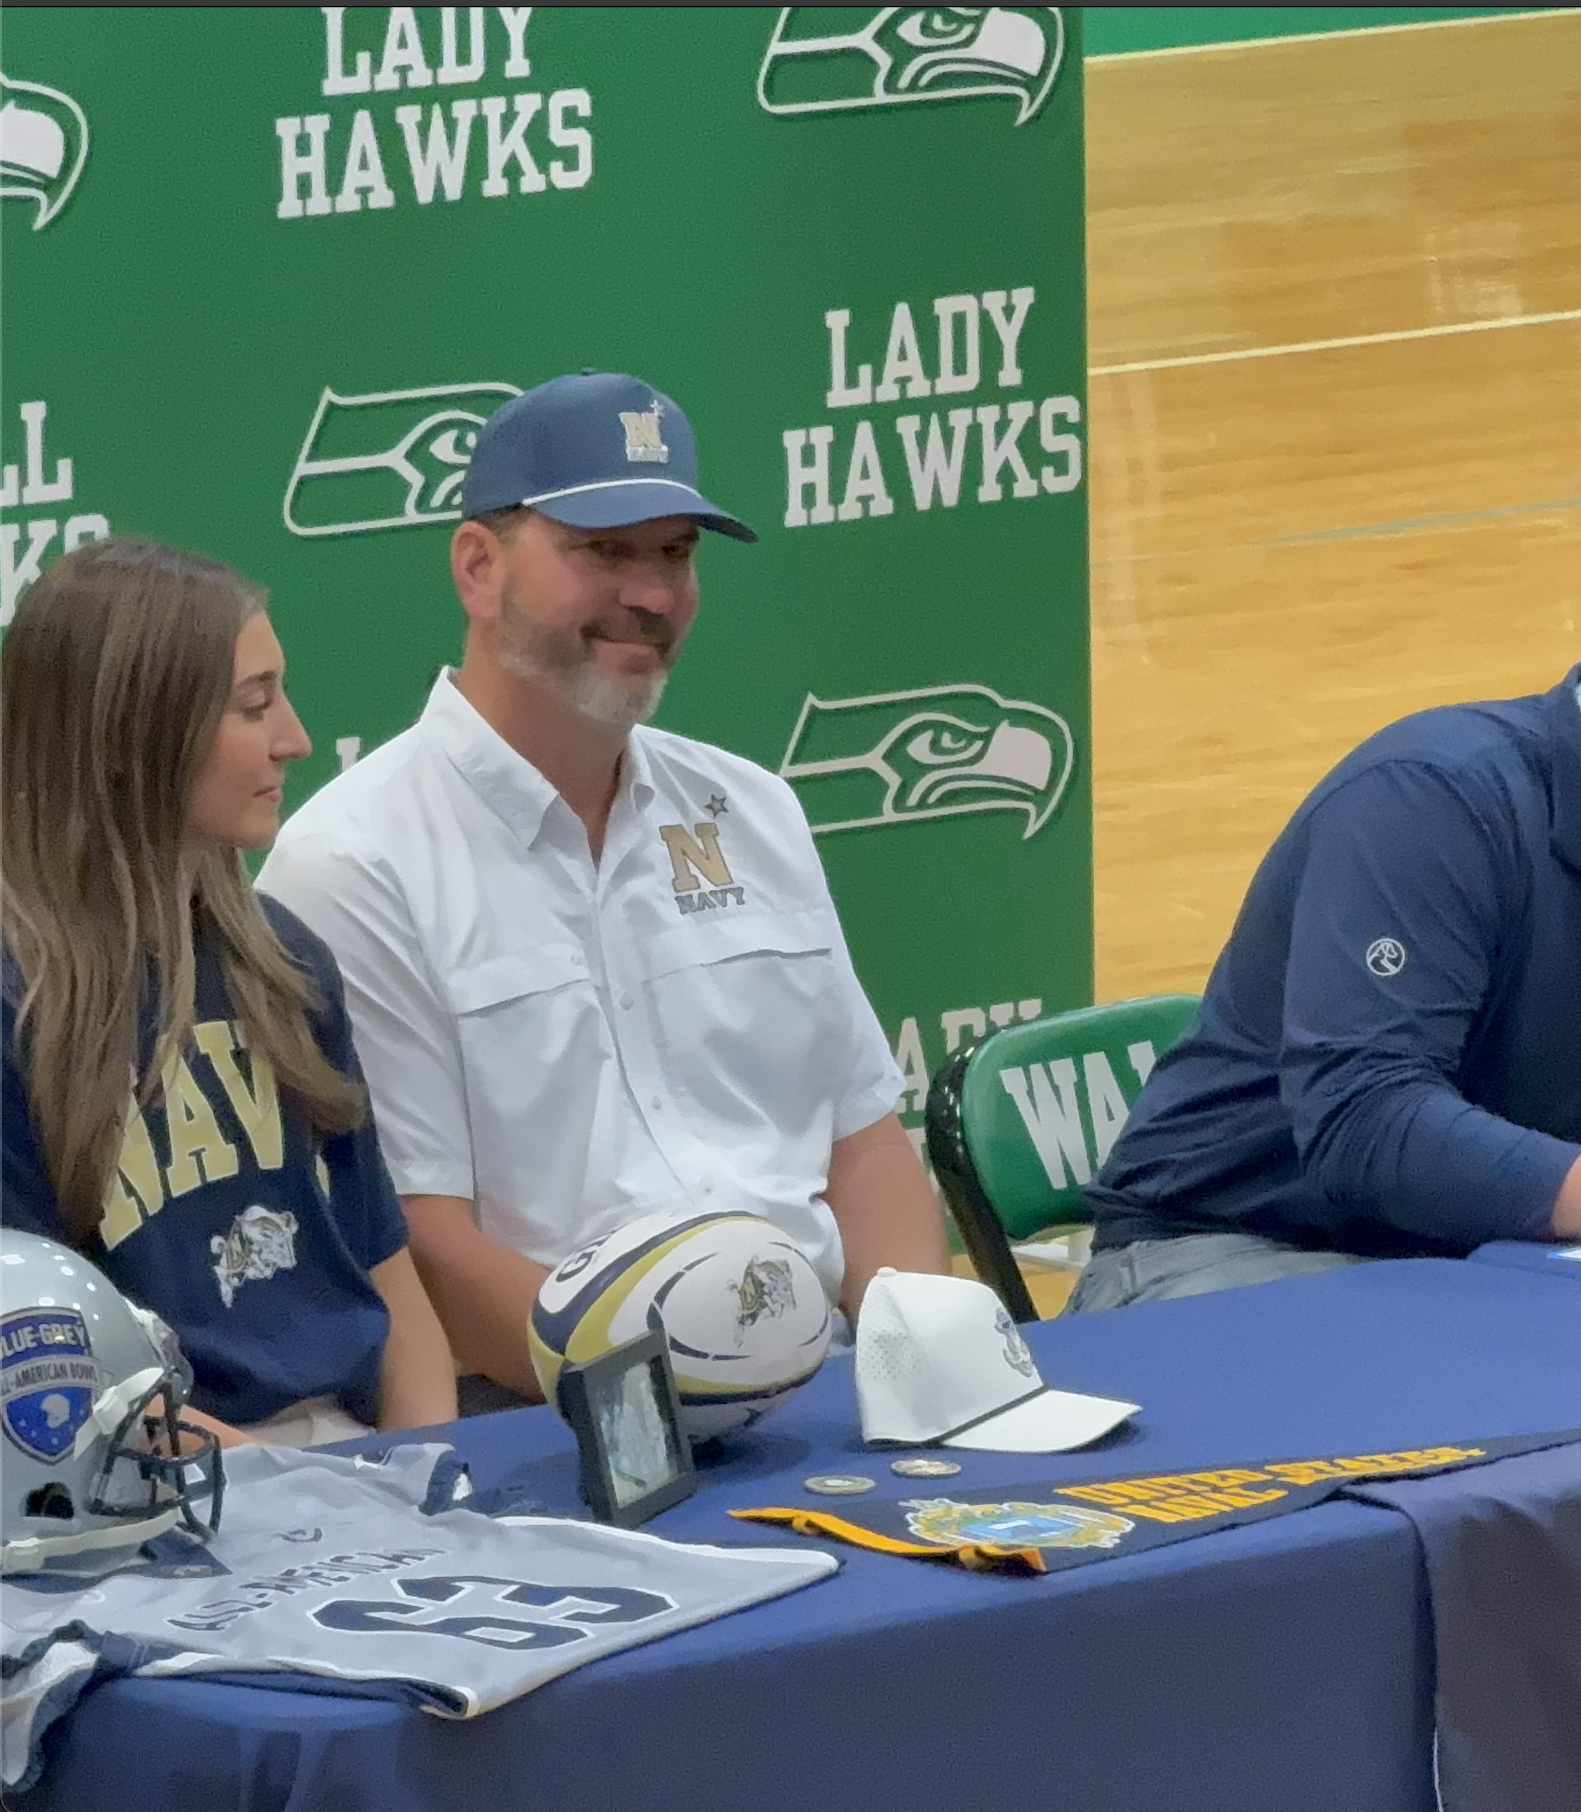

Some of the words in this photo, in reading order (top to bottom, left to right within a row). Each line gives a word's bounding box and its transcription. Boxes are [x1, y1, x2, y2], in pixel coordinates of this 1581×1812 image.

[321, 7, 532, 96] LADY
[275, 88, 593, 219] HAWKS
[825, 287, 1035, 408] LADY
[783, 395, 1082, 528] HAWKS
[659, 822, 734, 893] N
[674, 886, 746, 915] NAVY
[99, 1020, 285, 1252] NAV
[0, 1323, 86, 1359] LUE-GREY
[306, 1575, 681, 1651] 63
